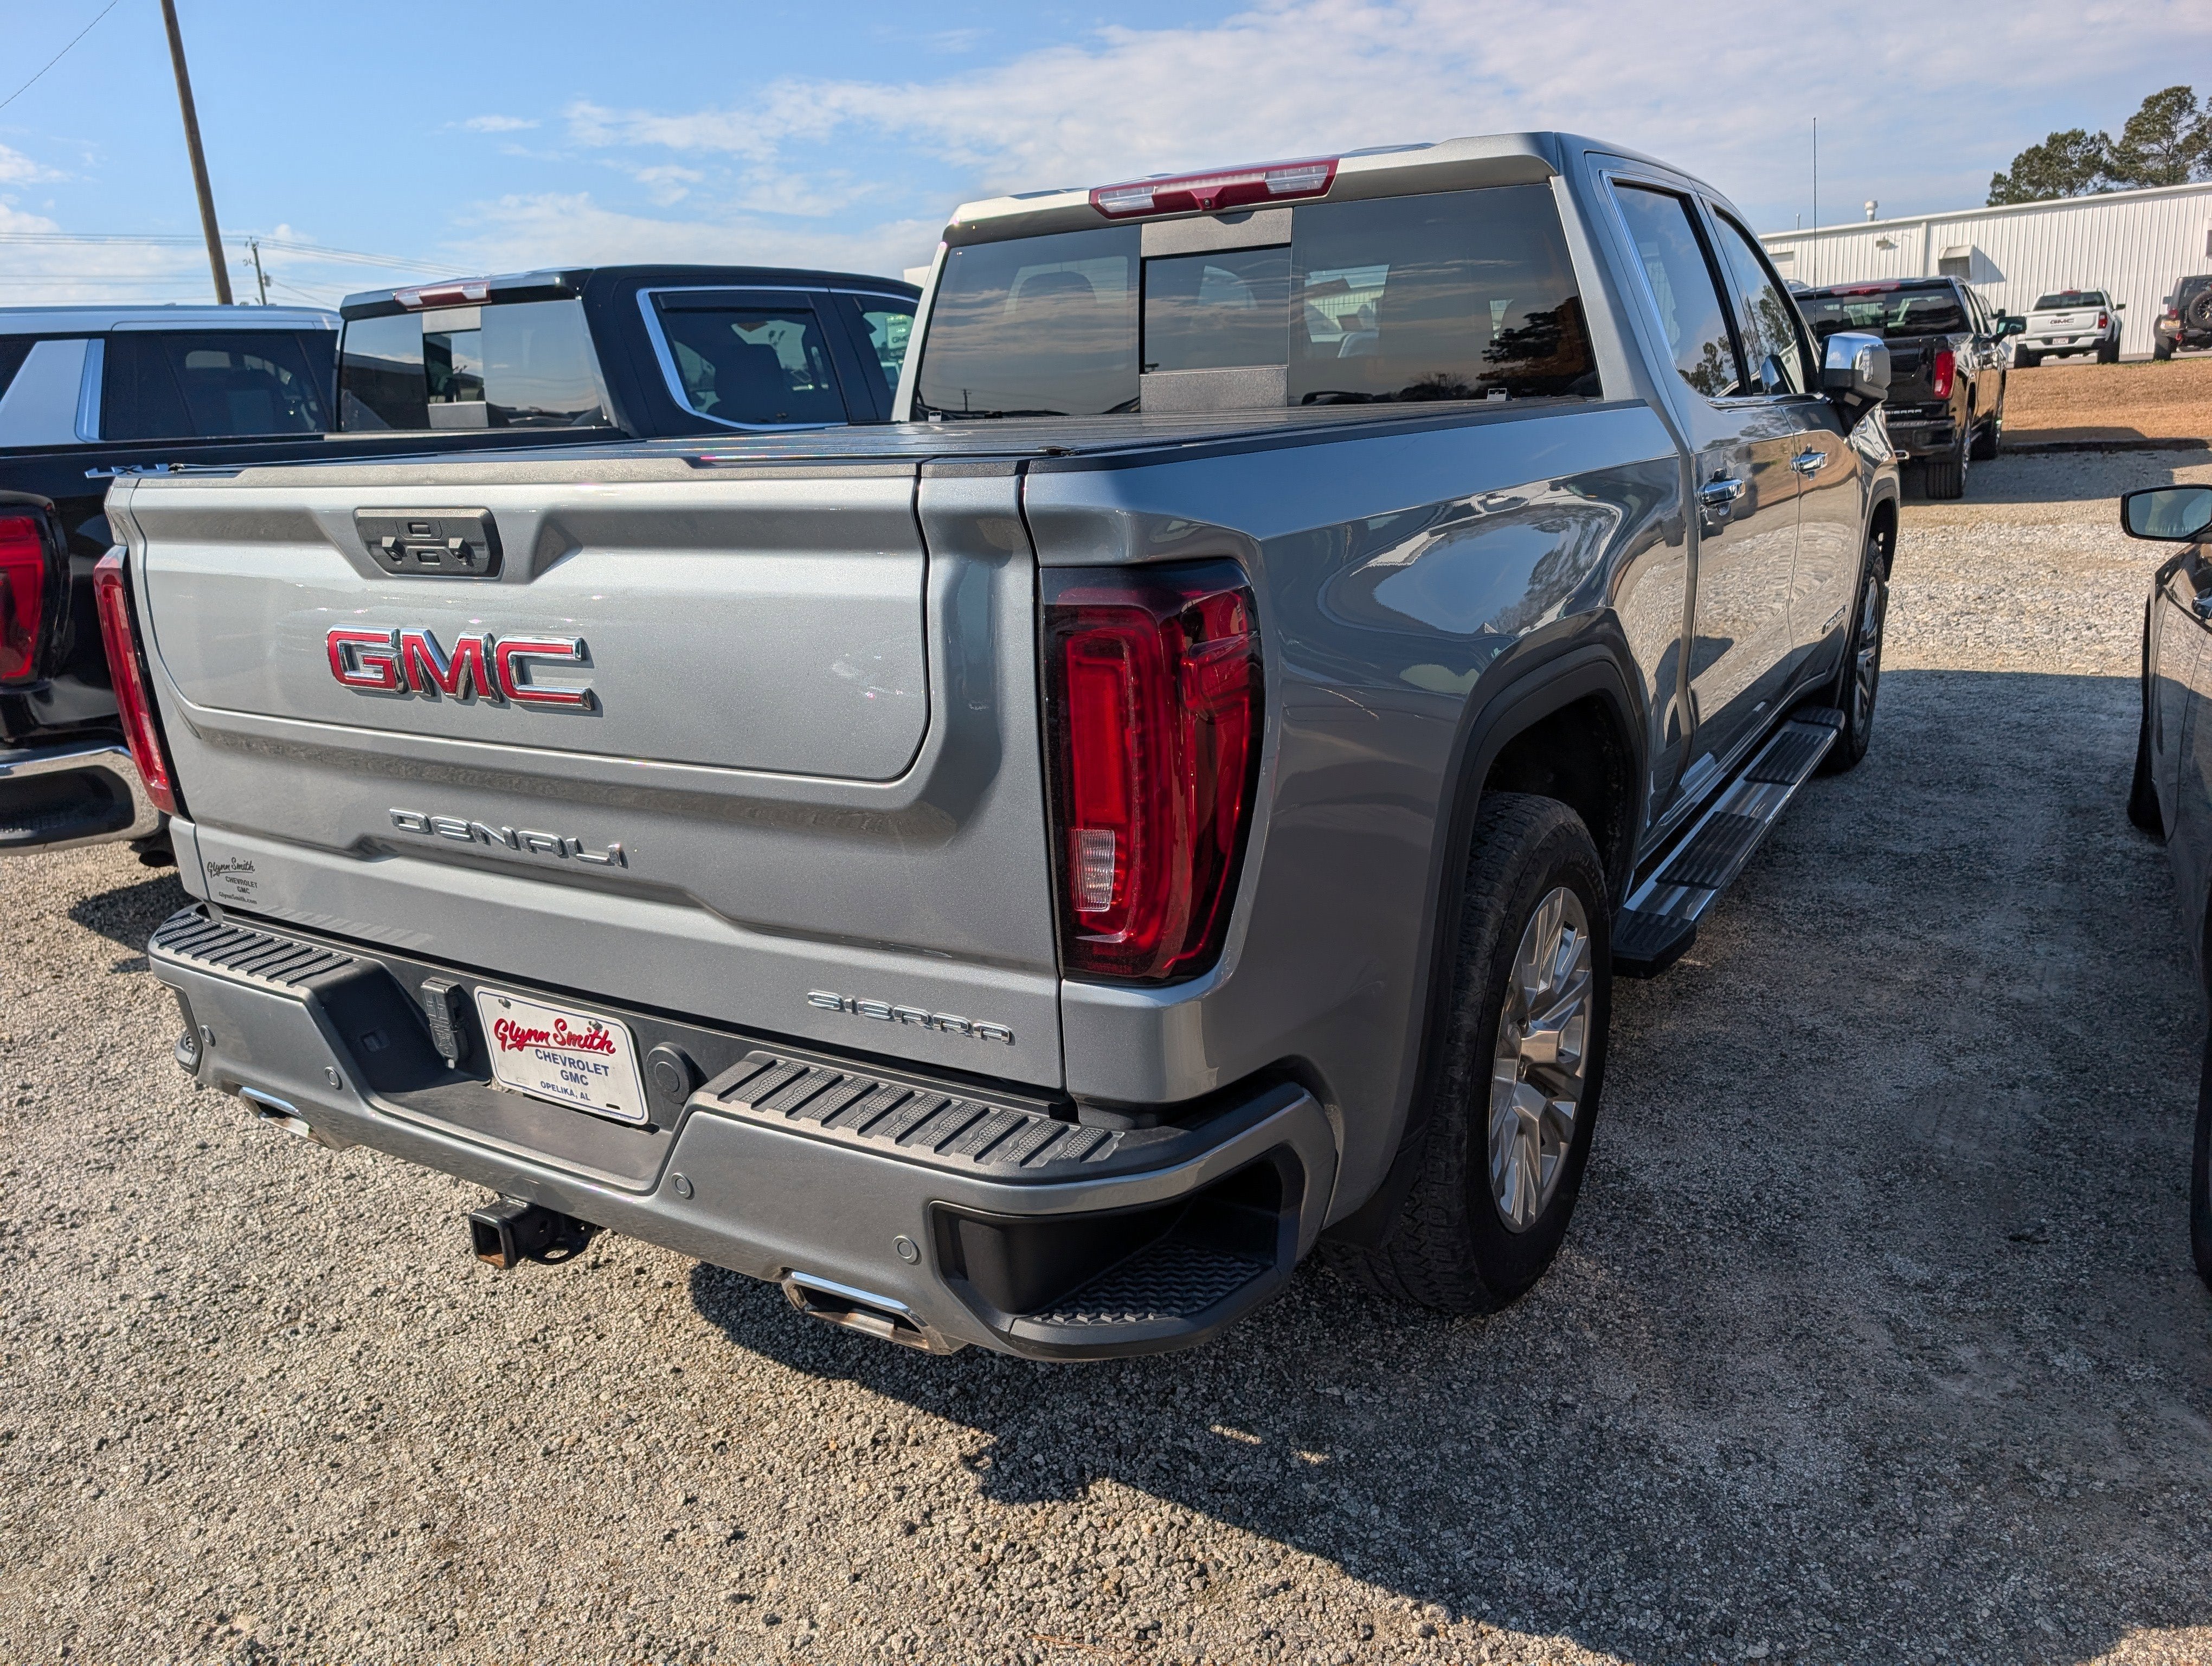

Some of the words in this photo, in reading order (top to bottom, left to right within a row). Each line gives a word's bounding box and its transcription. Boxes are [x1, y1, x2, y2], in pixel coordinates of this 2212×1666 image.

[326, 624, 595, 710] GMC
[389, 806, 623, 868] DENALI
[207, 861, 230, 878] Glynn
[231, 857, 255, 872] Smith
[225, 876, 258, 888] CHEVROLET
[237, 886, 250, 894] GMC
[218, 891, 258, 905] GlynnSmith.com
[807, 991, 1014, 1043] SIERRA
[494, 1018, 550, 1052] Glynn
[553, 1018, 616, 1054] Smith
[535, 1049, 609, 1077] CHEVROLET
[561, 1070, 589, 1086] GMC
[540, 1080, 577, 1099] OPELIKA,
[580, 1091, 591, 1101] AL
